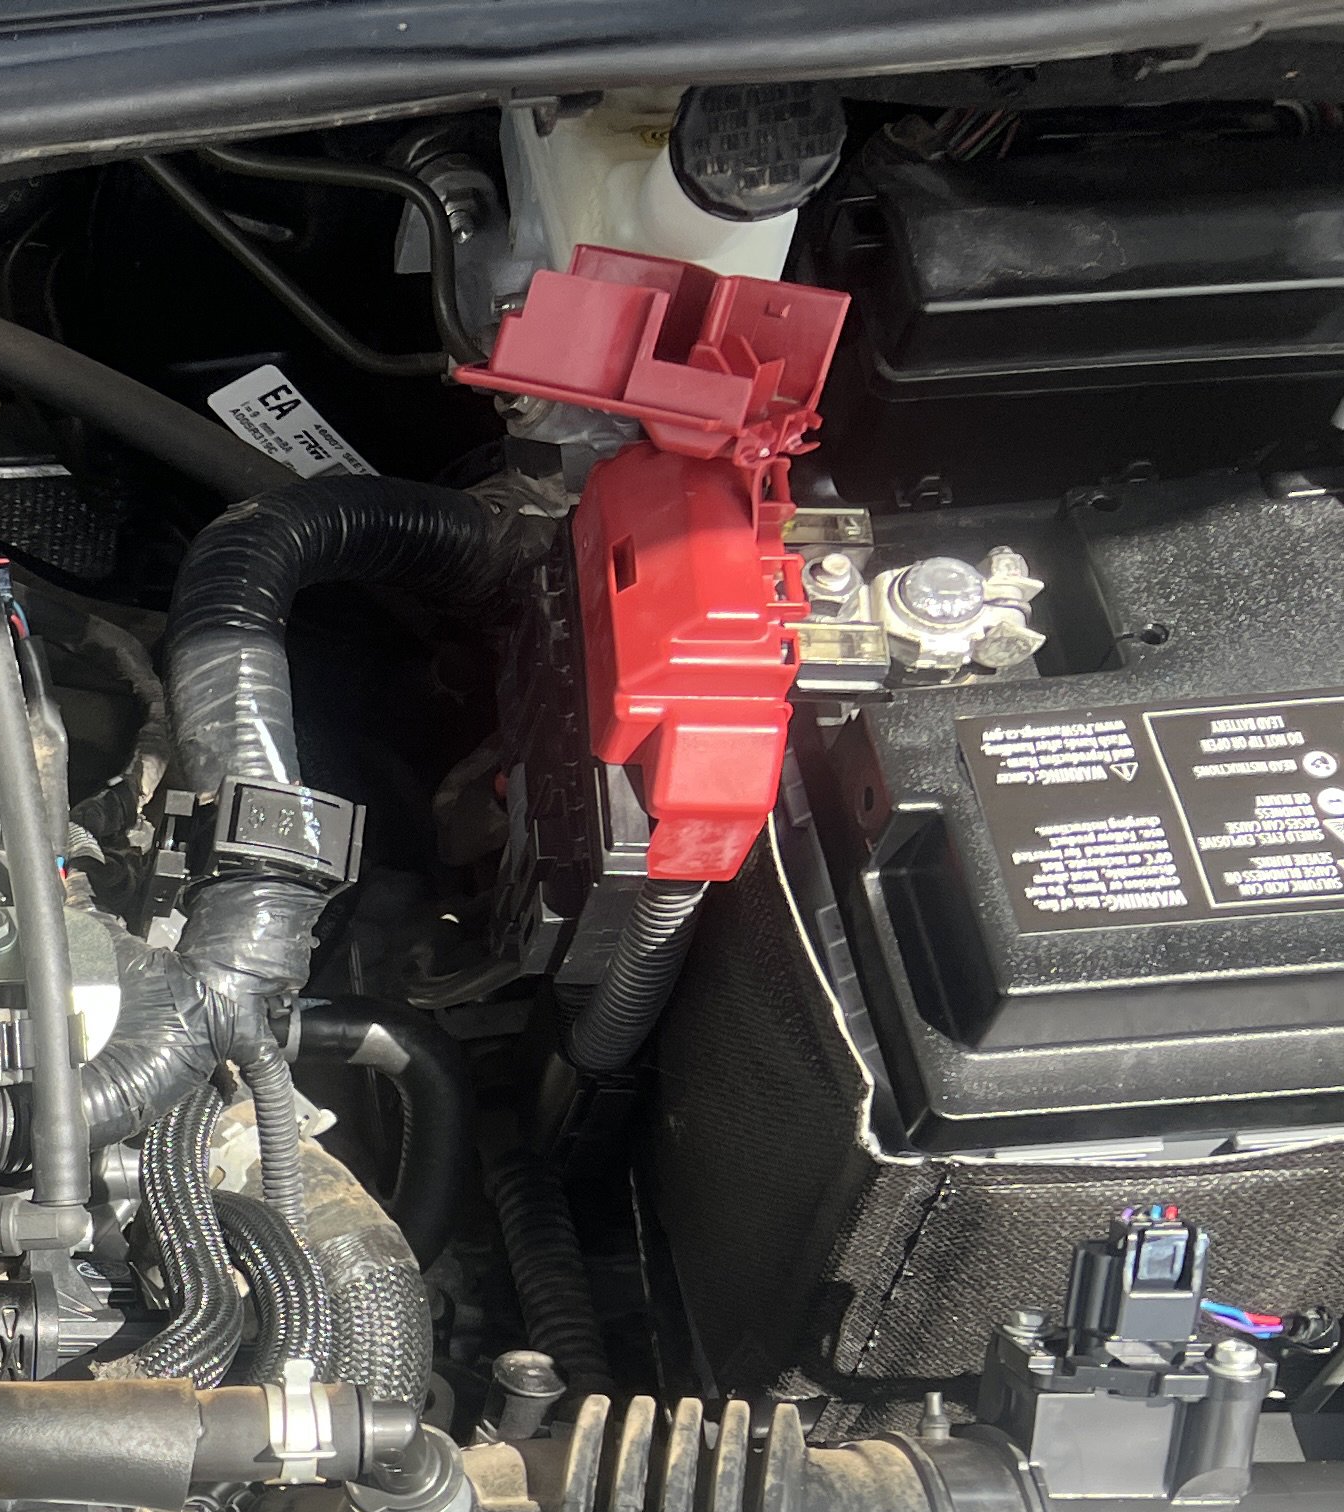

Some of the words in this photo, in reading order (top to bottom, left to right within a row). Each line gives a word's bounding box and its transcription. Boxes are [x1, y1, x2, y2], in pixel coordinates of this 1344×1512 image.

[257, 384, 302, 421] EA
[293, 429, 332, 461] TRW
[1210, 718, 1257, 734] BATTERY
[1256, 715, 1285, 730] LEAD
[1035, 739, 1064, 753] after
[1063, 737, 1099, 750] hands
[1097, 733, 1132, 748] Wash
[1200, 737, 1232, 753] OPEN
[1248, 735, 1266, 749] TIP
[1265, 733, 1288, 748] NOT
[1287, 731, 1305, 746] DO
[1038, 750, 1112, 767] Reproductive
[1111, 747, 1136, 761] and
[1006, 756, 1039, 769] Harm
[1268, 759, 1298, 774] READ
[1034, 765, 1109, 786] WARNING:
[1192, 761, 1269, 780] INSTRUCTIONS
[996, 771, 1035, 786] Cancer
[1294, 792, 1312, 805] OR
[1254, 804, 1316, 820] BLINDNESS
[1108, 815, 1162, 830] charging
[1224, 820, 1261, 835] CAUSE
[1261, 819, 1286, 832] CAN
[1285, 817, 1320, 830] GASES
[1049, 832, 1097, 848] product
[1197, 834, 1256, 851] EXPLOSIVE
[1285, 829, 1325, 843] SHIELD
[1294, 851, 1334, 866] SEVERE
[1223, 871, 1242, 886] OR
[1242, 868, 1303, 883] BLINDNESS
[1303, 865, 1339, 878] CAUSE
[1123, 875, 1181, 891] explosion
[1238, 883, 1264, 897] CAN
[1264, 881, 1291, 895] ACID
[1073, 896, 1100, 911] Risk
[1101, 889, 1188, 912] WARNING:
